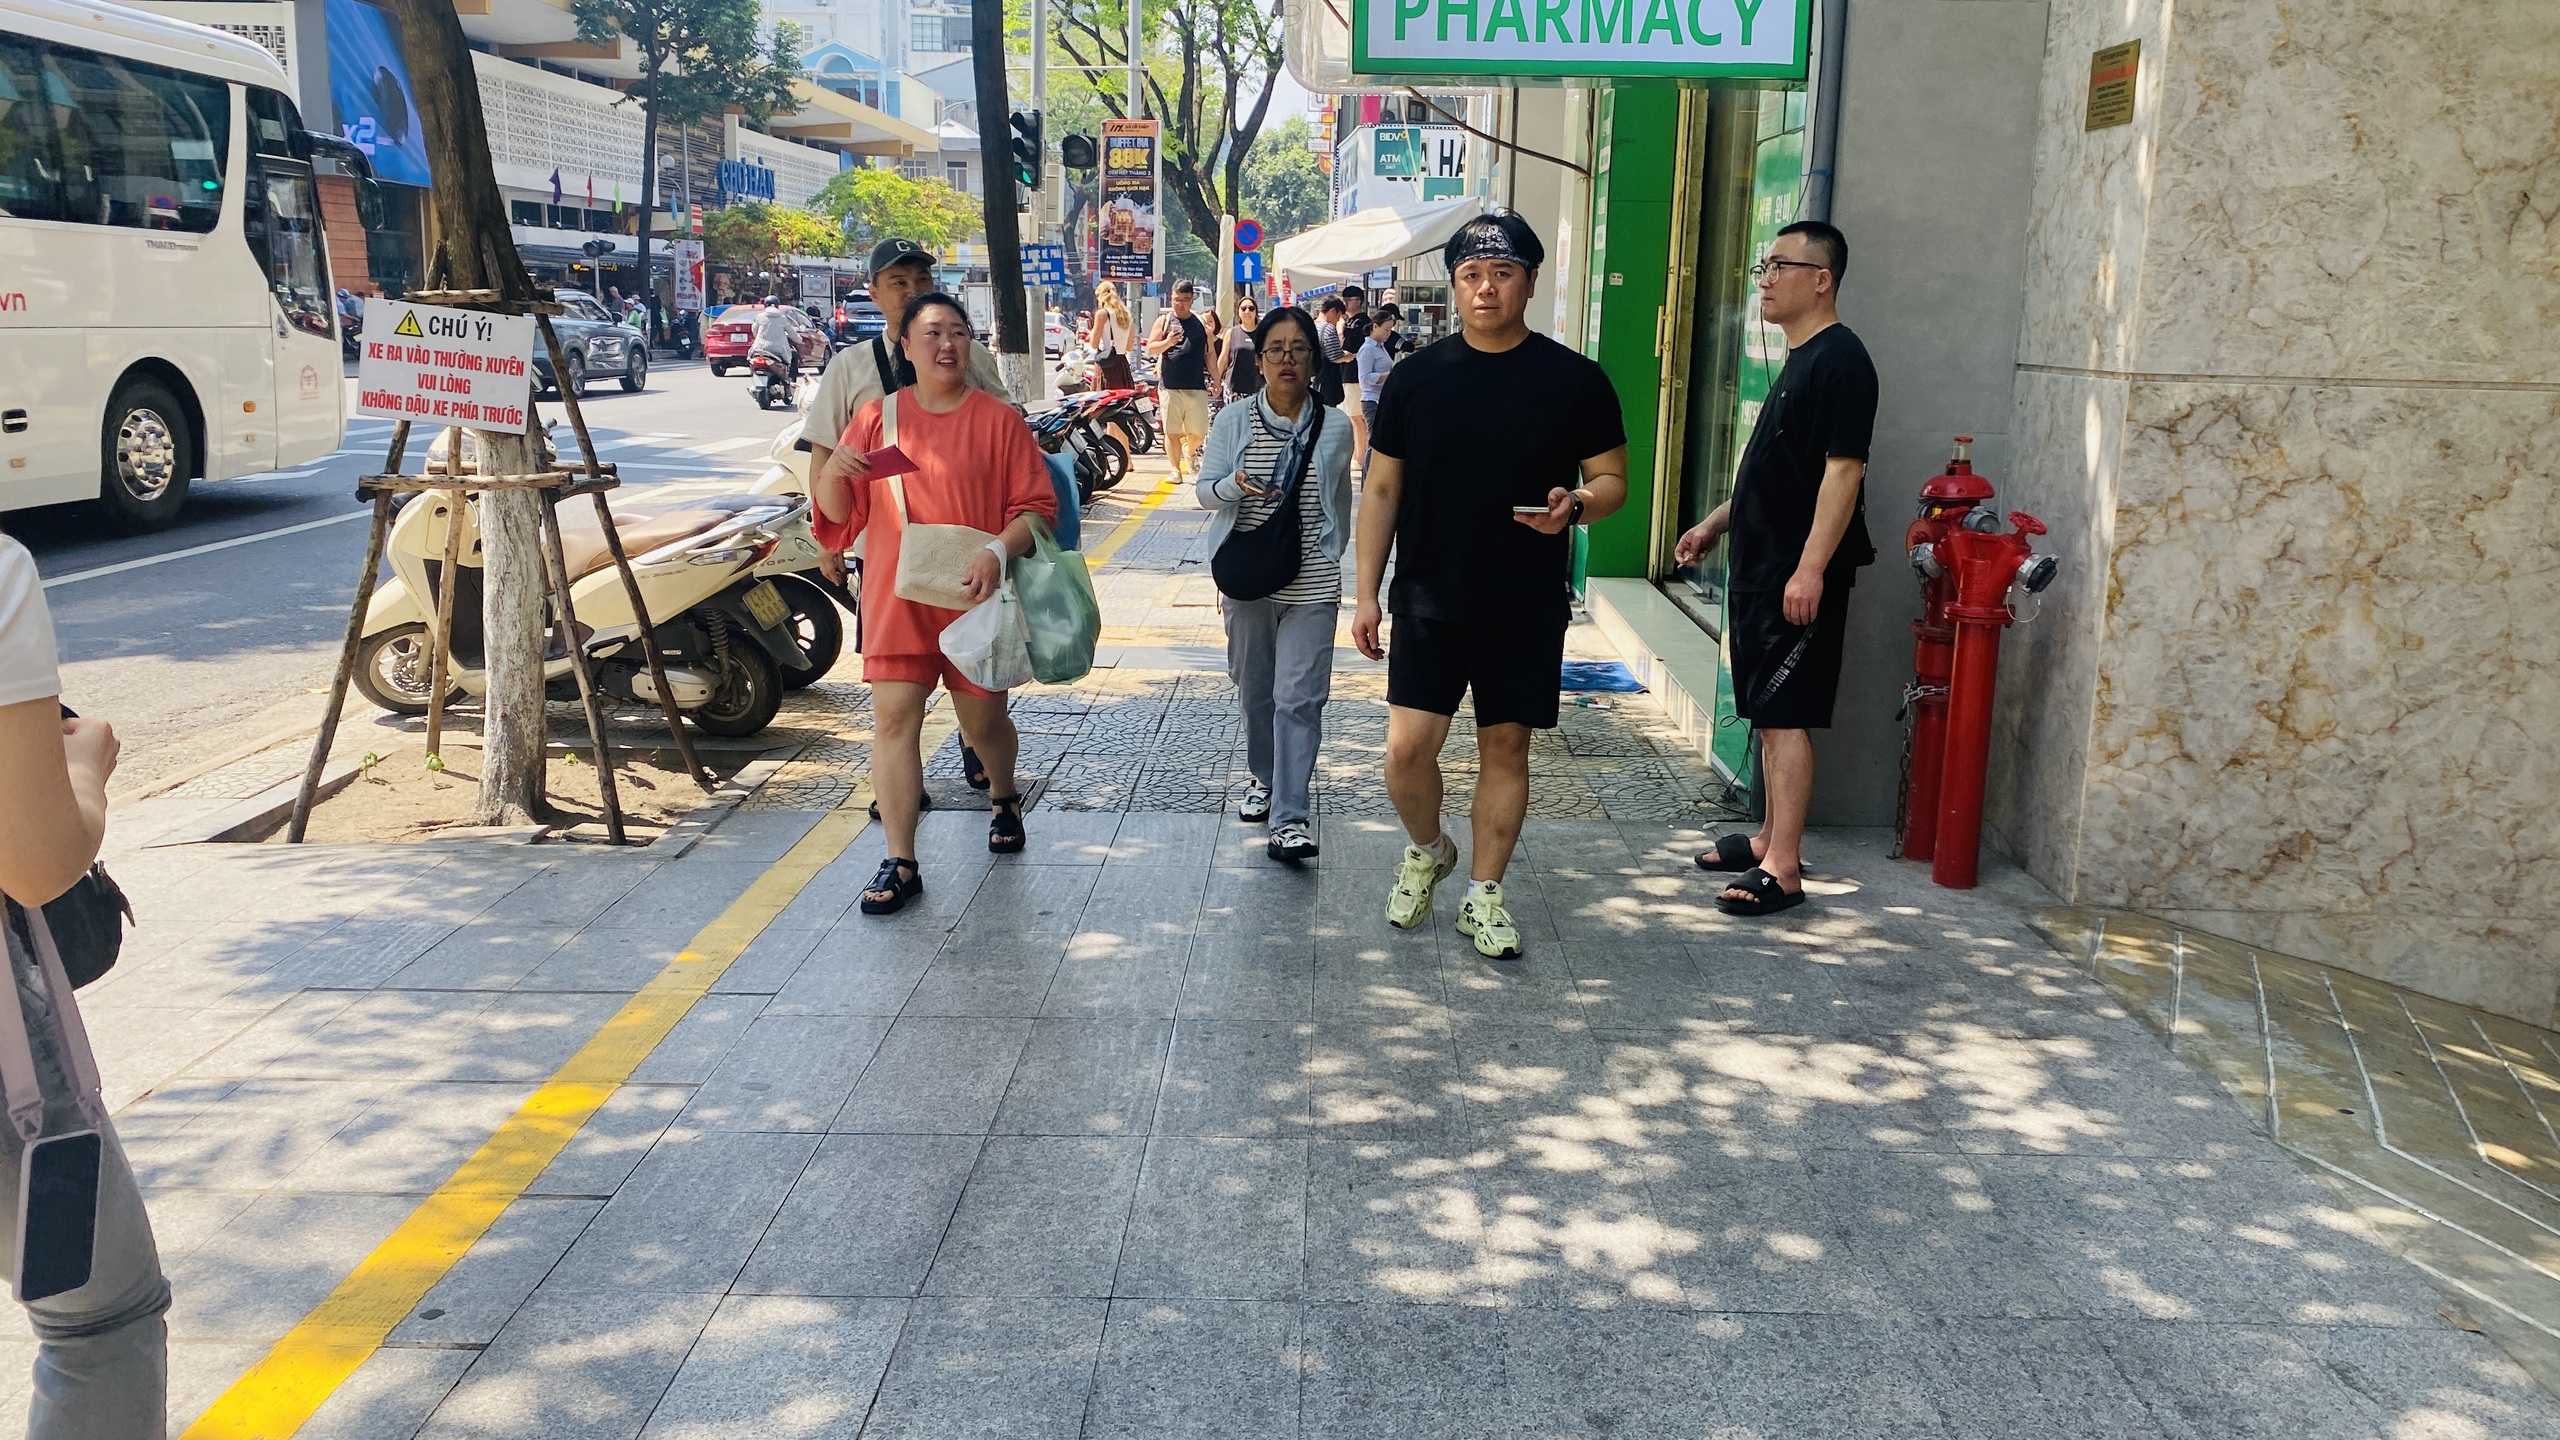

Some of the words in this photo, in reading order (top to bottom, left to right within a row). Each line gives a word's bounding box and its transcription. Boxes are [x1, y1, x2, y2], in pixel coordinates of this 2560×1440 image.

[1394, 0, 1760, 46] PHARMACY
[1379, 132, 1401, 142] BIDV
[1379, 154, 1401, 163] ATM
[428, 313, 468, 339] CHÚ
[474, 315, 493, 342] Ý!
[368, 342, 383, 358] XE
[386, 344, 403, 362] RA
[406, 344, 430, 365] VÀO
[434, 349, 482, 372] THƯỜNG
[485, 355, 525, 377] XUYÊN
[417, 372, 436, 391] VUI
[440, 373, 471, 395] LÒNG
[361, 388, 402, 411] KHÔNG
[405, 393, 430, 418] ĐẬU
[432, 399, 449, 416] XE
[451, 400, 479, 421] PHÍA
[482, 405, 523, 426] TRƯỚC
